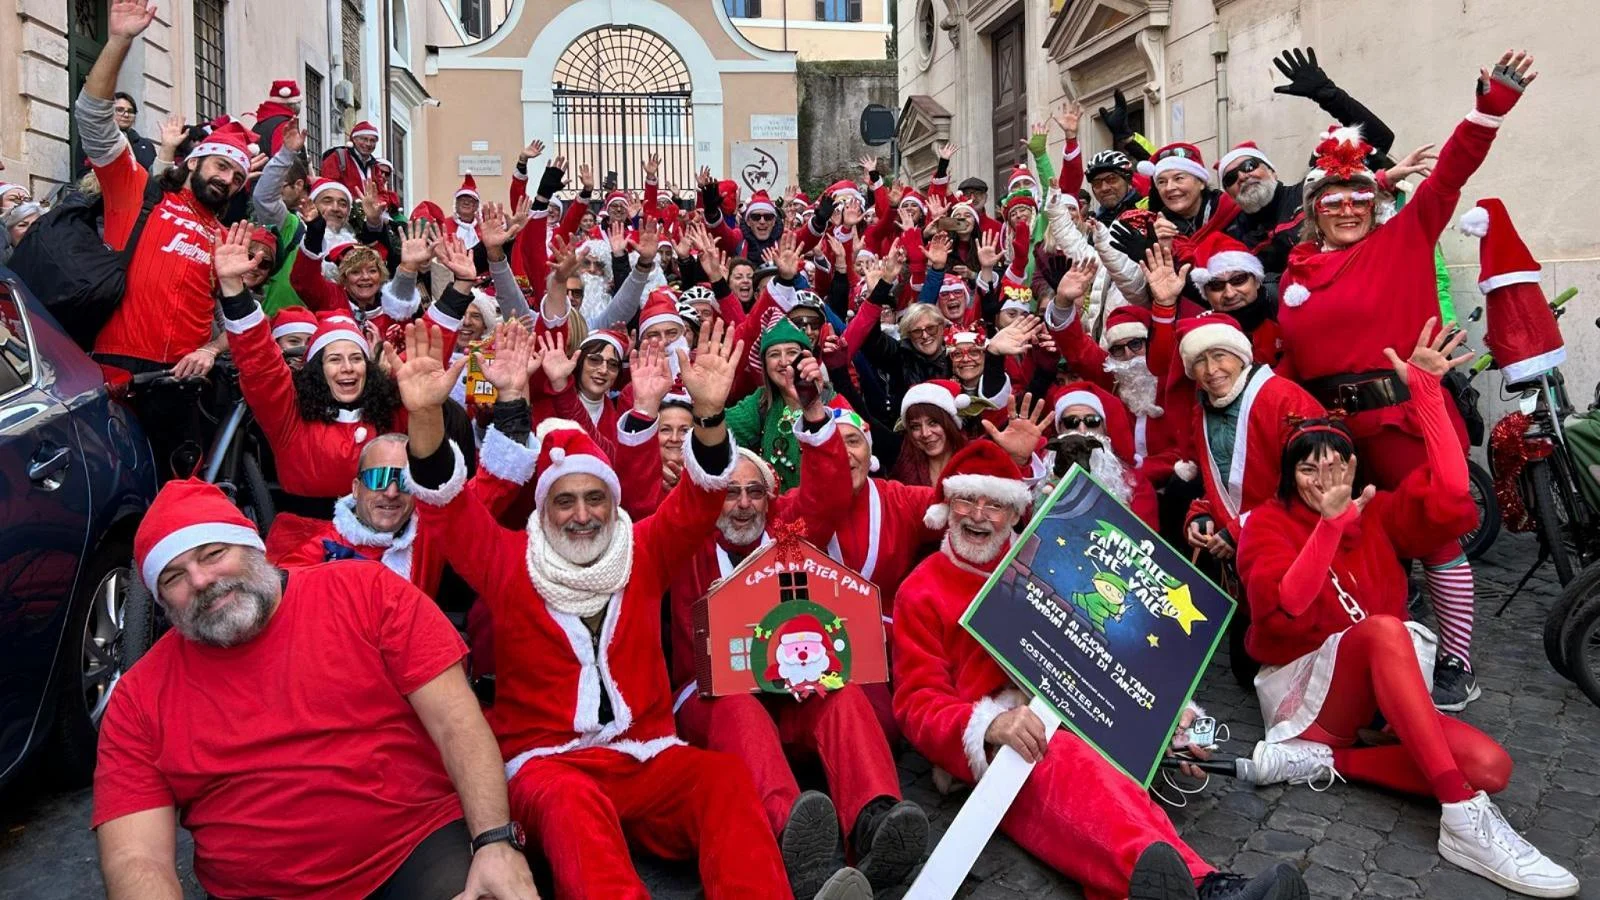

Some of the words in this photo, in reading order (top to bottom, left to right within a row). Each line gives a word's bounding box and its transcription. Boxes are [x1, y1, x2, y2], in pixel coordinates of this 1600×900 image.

[745, 561, 786, 586] CASA
[803, 558, 838, 580] PETER
[840, 575, 871, 596] PAN
[1087, 545, 1124, 576] CHE
[1128, 576, 1164, 619] VALE
[1090, 531, 1110, 550] FAI
[1116, 551, 1133, 568] UN
[1135, 570, 1180, 617] REGALO
[1106, 530, 1170, 588] NATALE
[1140, 539, 1155, 556] A
[1026, 581, 1044, 599] DAI
[1046, 599, 1067, 621] VITA
[1068, 620, 1080, 632] AI
[1081, 632, 1113, 664] GIORNI
[1115, 662, 1127, 676] DI
[1129, 676, 1156, 703] TANTI
[1026, 592, 1063, 628] BAMBINI
[1064, 628, 1095, 659] MALATI
[1096, 658, 1109, 672] DI
[1110, 672, 1147, 707] CANCRO
[1020, 637, 1063, 680] SOSTIENI
[1062, 678, 1093, 708] PETER
[1093, 706, 1114, 728] PAN
[1039, 676, 1059, 702] Peter
[1057, 698, 1076, 718] Pan
